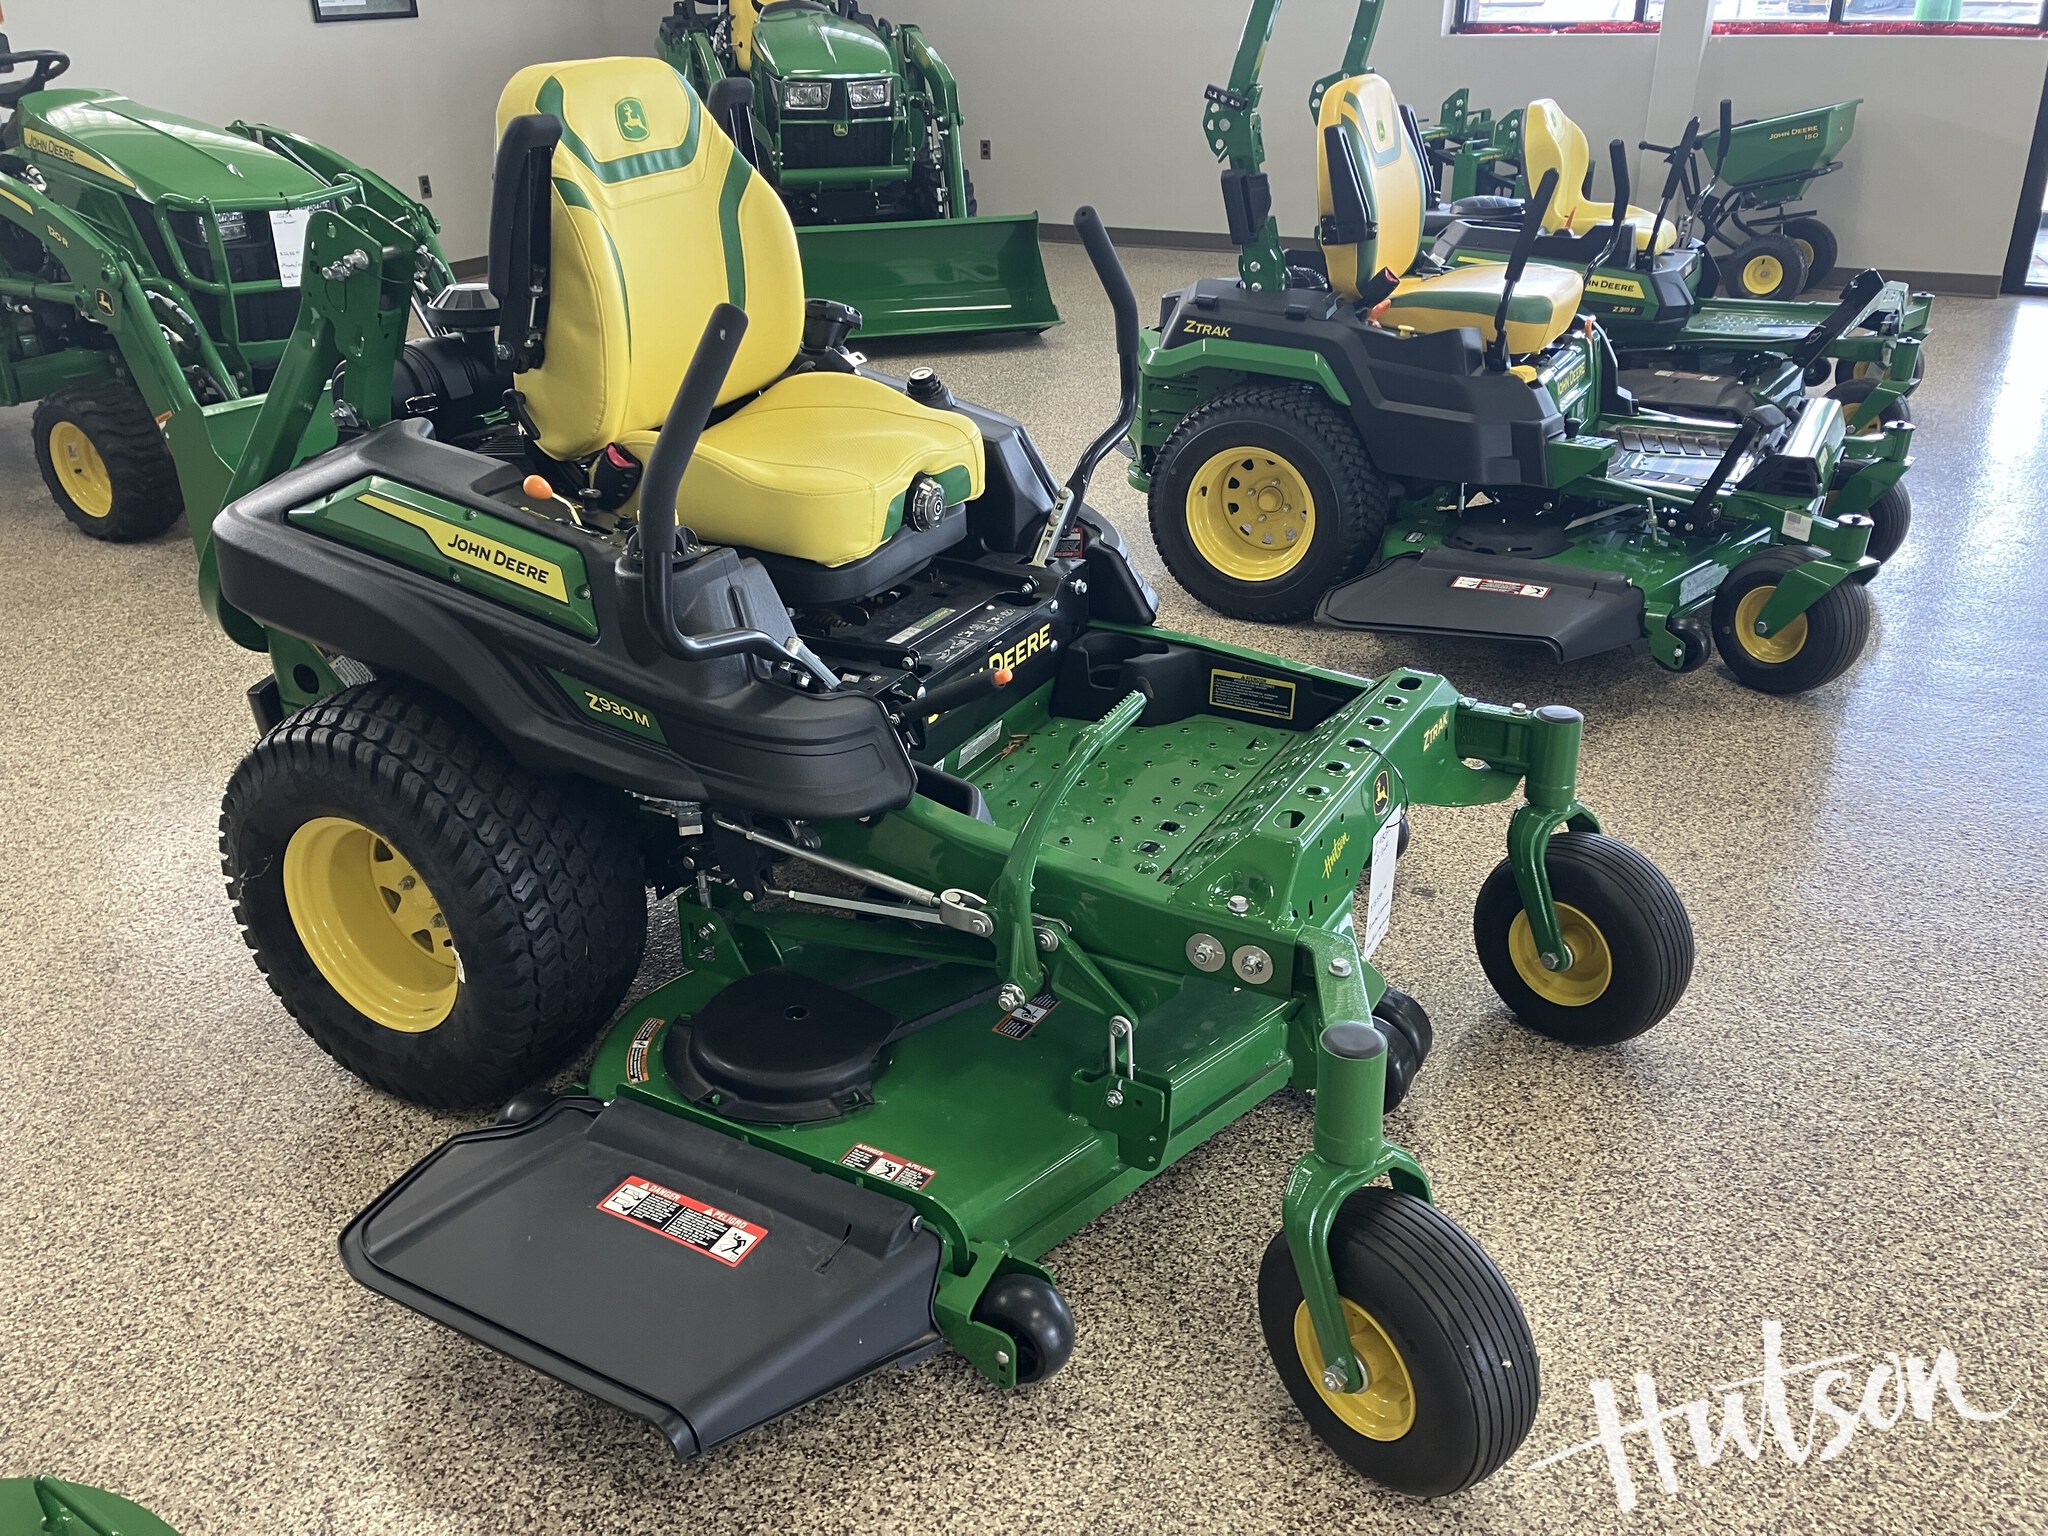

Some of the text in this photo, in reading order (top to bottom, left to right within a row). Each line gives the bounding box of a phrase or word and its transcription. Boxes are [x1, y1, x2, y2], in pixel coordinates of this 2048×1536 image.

[27, 134, 75, 163] JOHN DEERE
[1769, 125, 1818, 140] JOHN DEERE
[1804, 132, 1819, 140] 150
[1600, 280, 1635, 292] DEERE
[1183, 319, 1231, 337] ZTRAK
[447, 533, 549, 584] JOHN DEERE
[989, 623, 1051, 672] DEERE
[584, 691, 650, 728] Z930M
[1423, 709, 1449, 752] ZTRAK
[1321, 831, 1350, 879] Hutson
[648, 1184, 682, 1202] DANGER
[711, 1210, 748, 1229] PELIGRO
